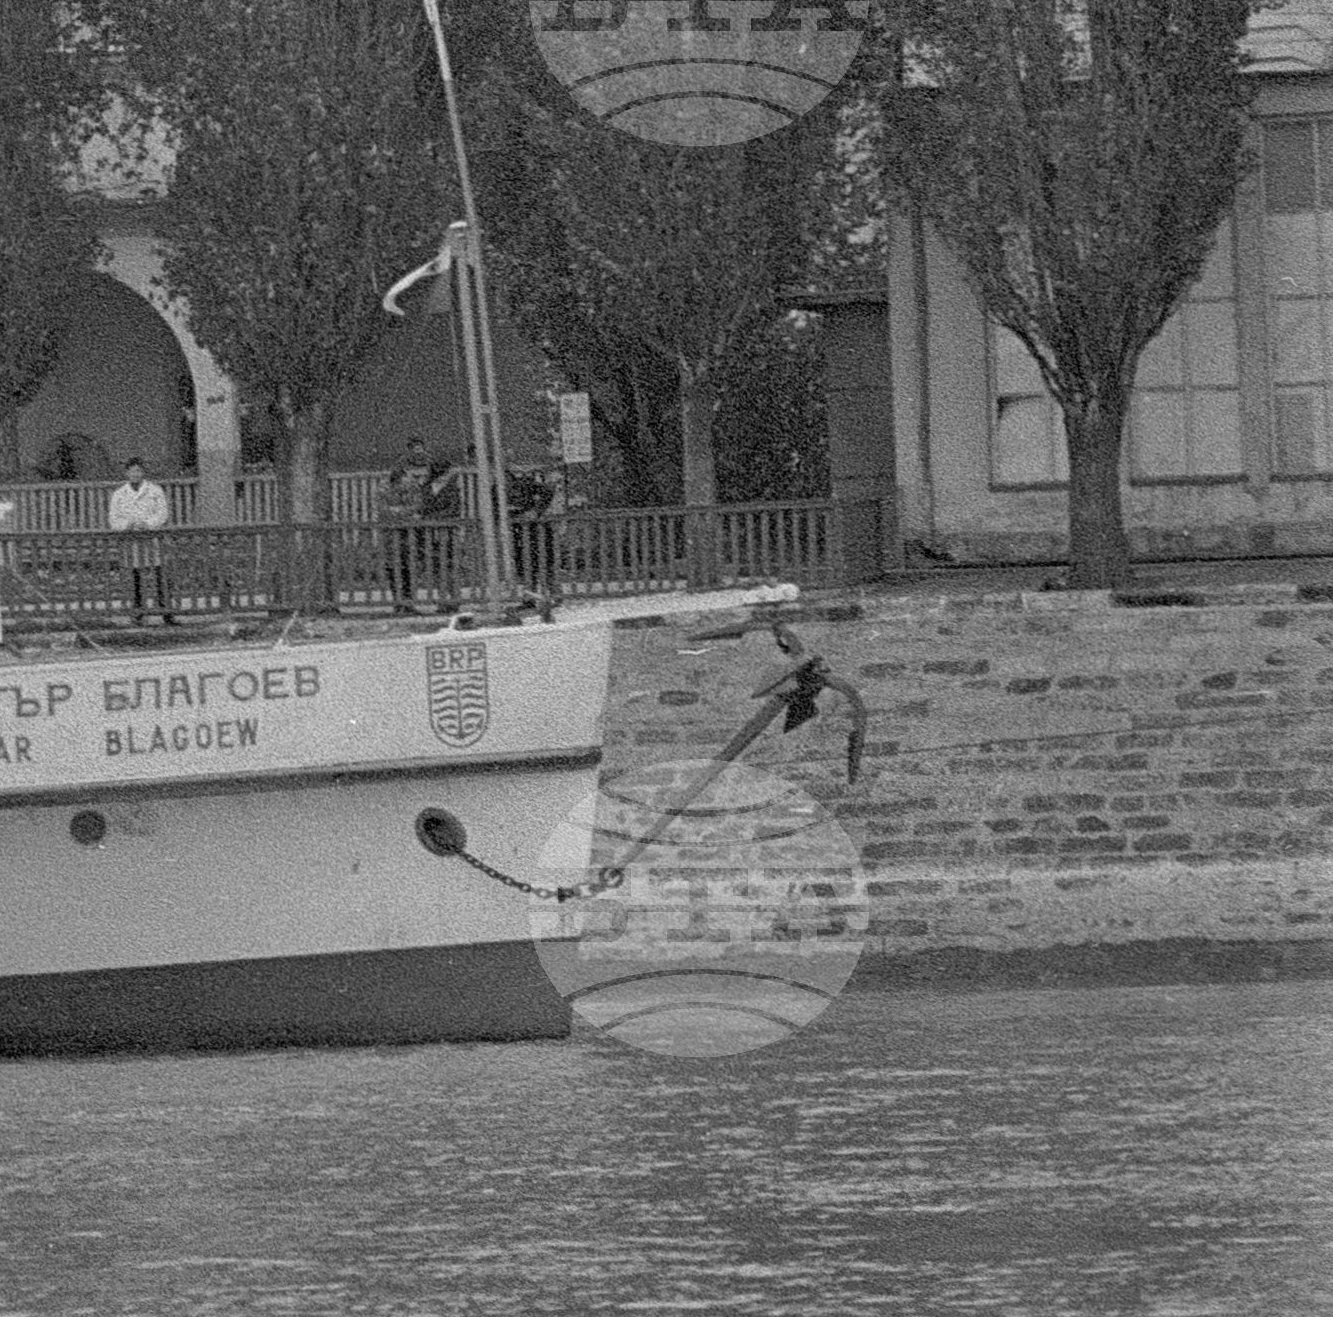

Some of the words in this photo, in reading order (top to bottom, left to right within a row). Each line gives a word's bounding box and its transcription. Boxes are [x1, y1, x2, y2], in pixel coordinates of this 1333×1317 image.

[430, 647, 484, 671] BRP
[103, 665, 322, 712] БЛАГОЕВ
[105, 718, 259, 757] BLAGOEW
